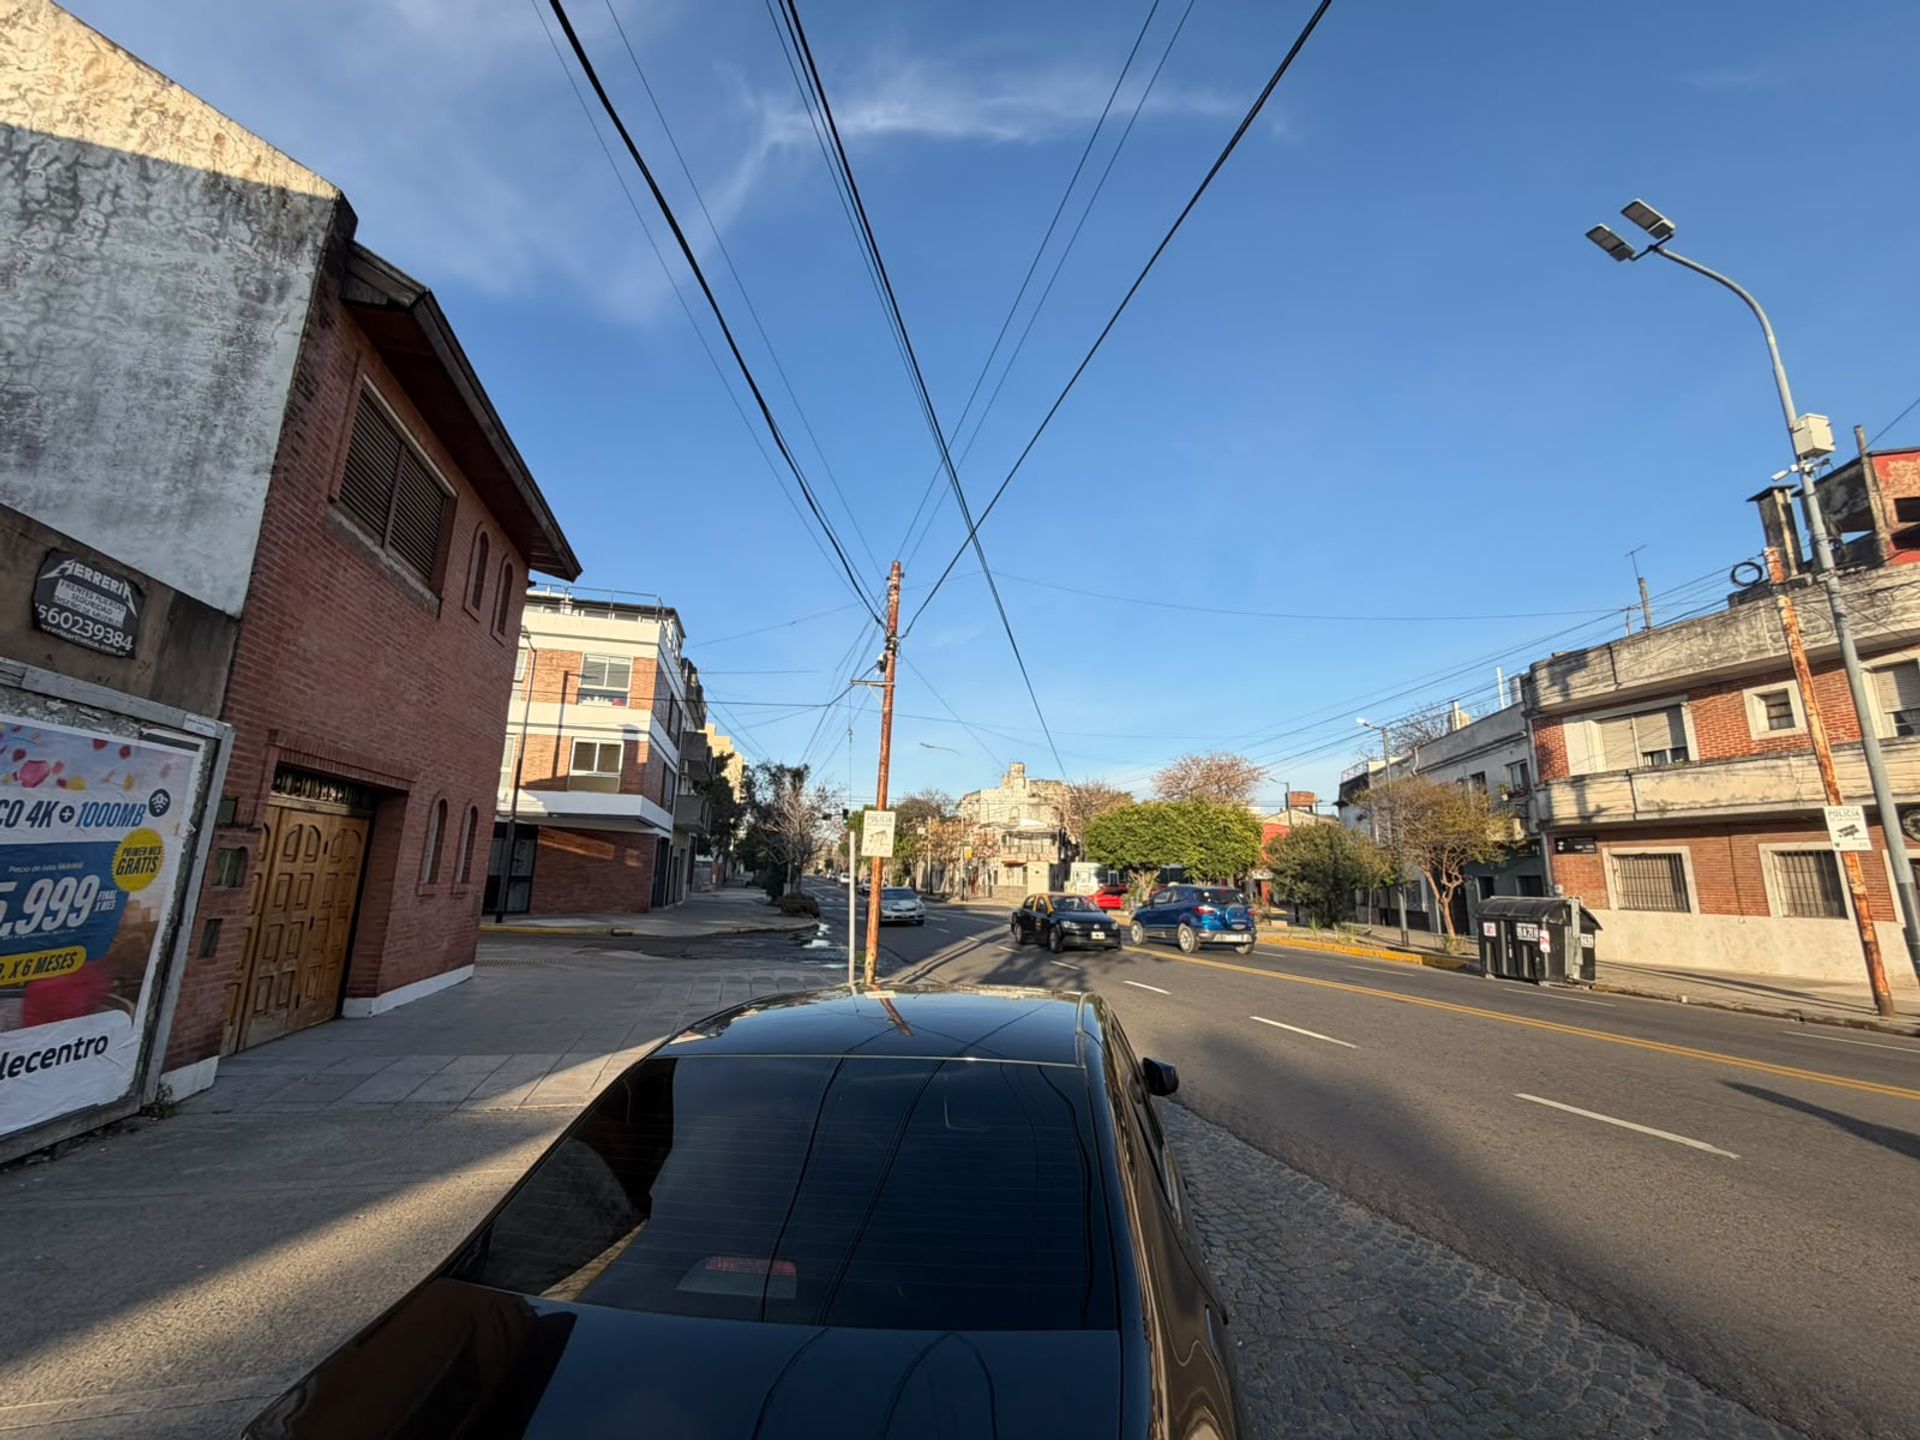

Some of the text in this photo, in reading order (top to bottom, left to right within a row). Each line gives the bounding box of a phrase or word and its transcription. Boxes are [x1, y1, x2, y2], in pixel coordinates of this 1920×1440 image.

[25, 800, 61, 828] 4K
[75, 801, 147, 828] 1000MB
[116, 855, 159, 875] GRATIS
[21, 958, 33, 977] 6
[32, 951, 78, 975] MESES
